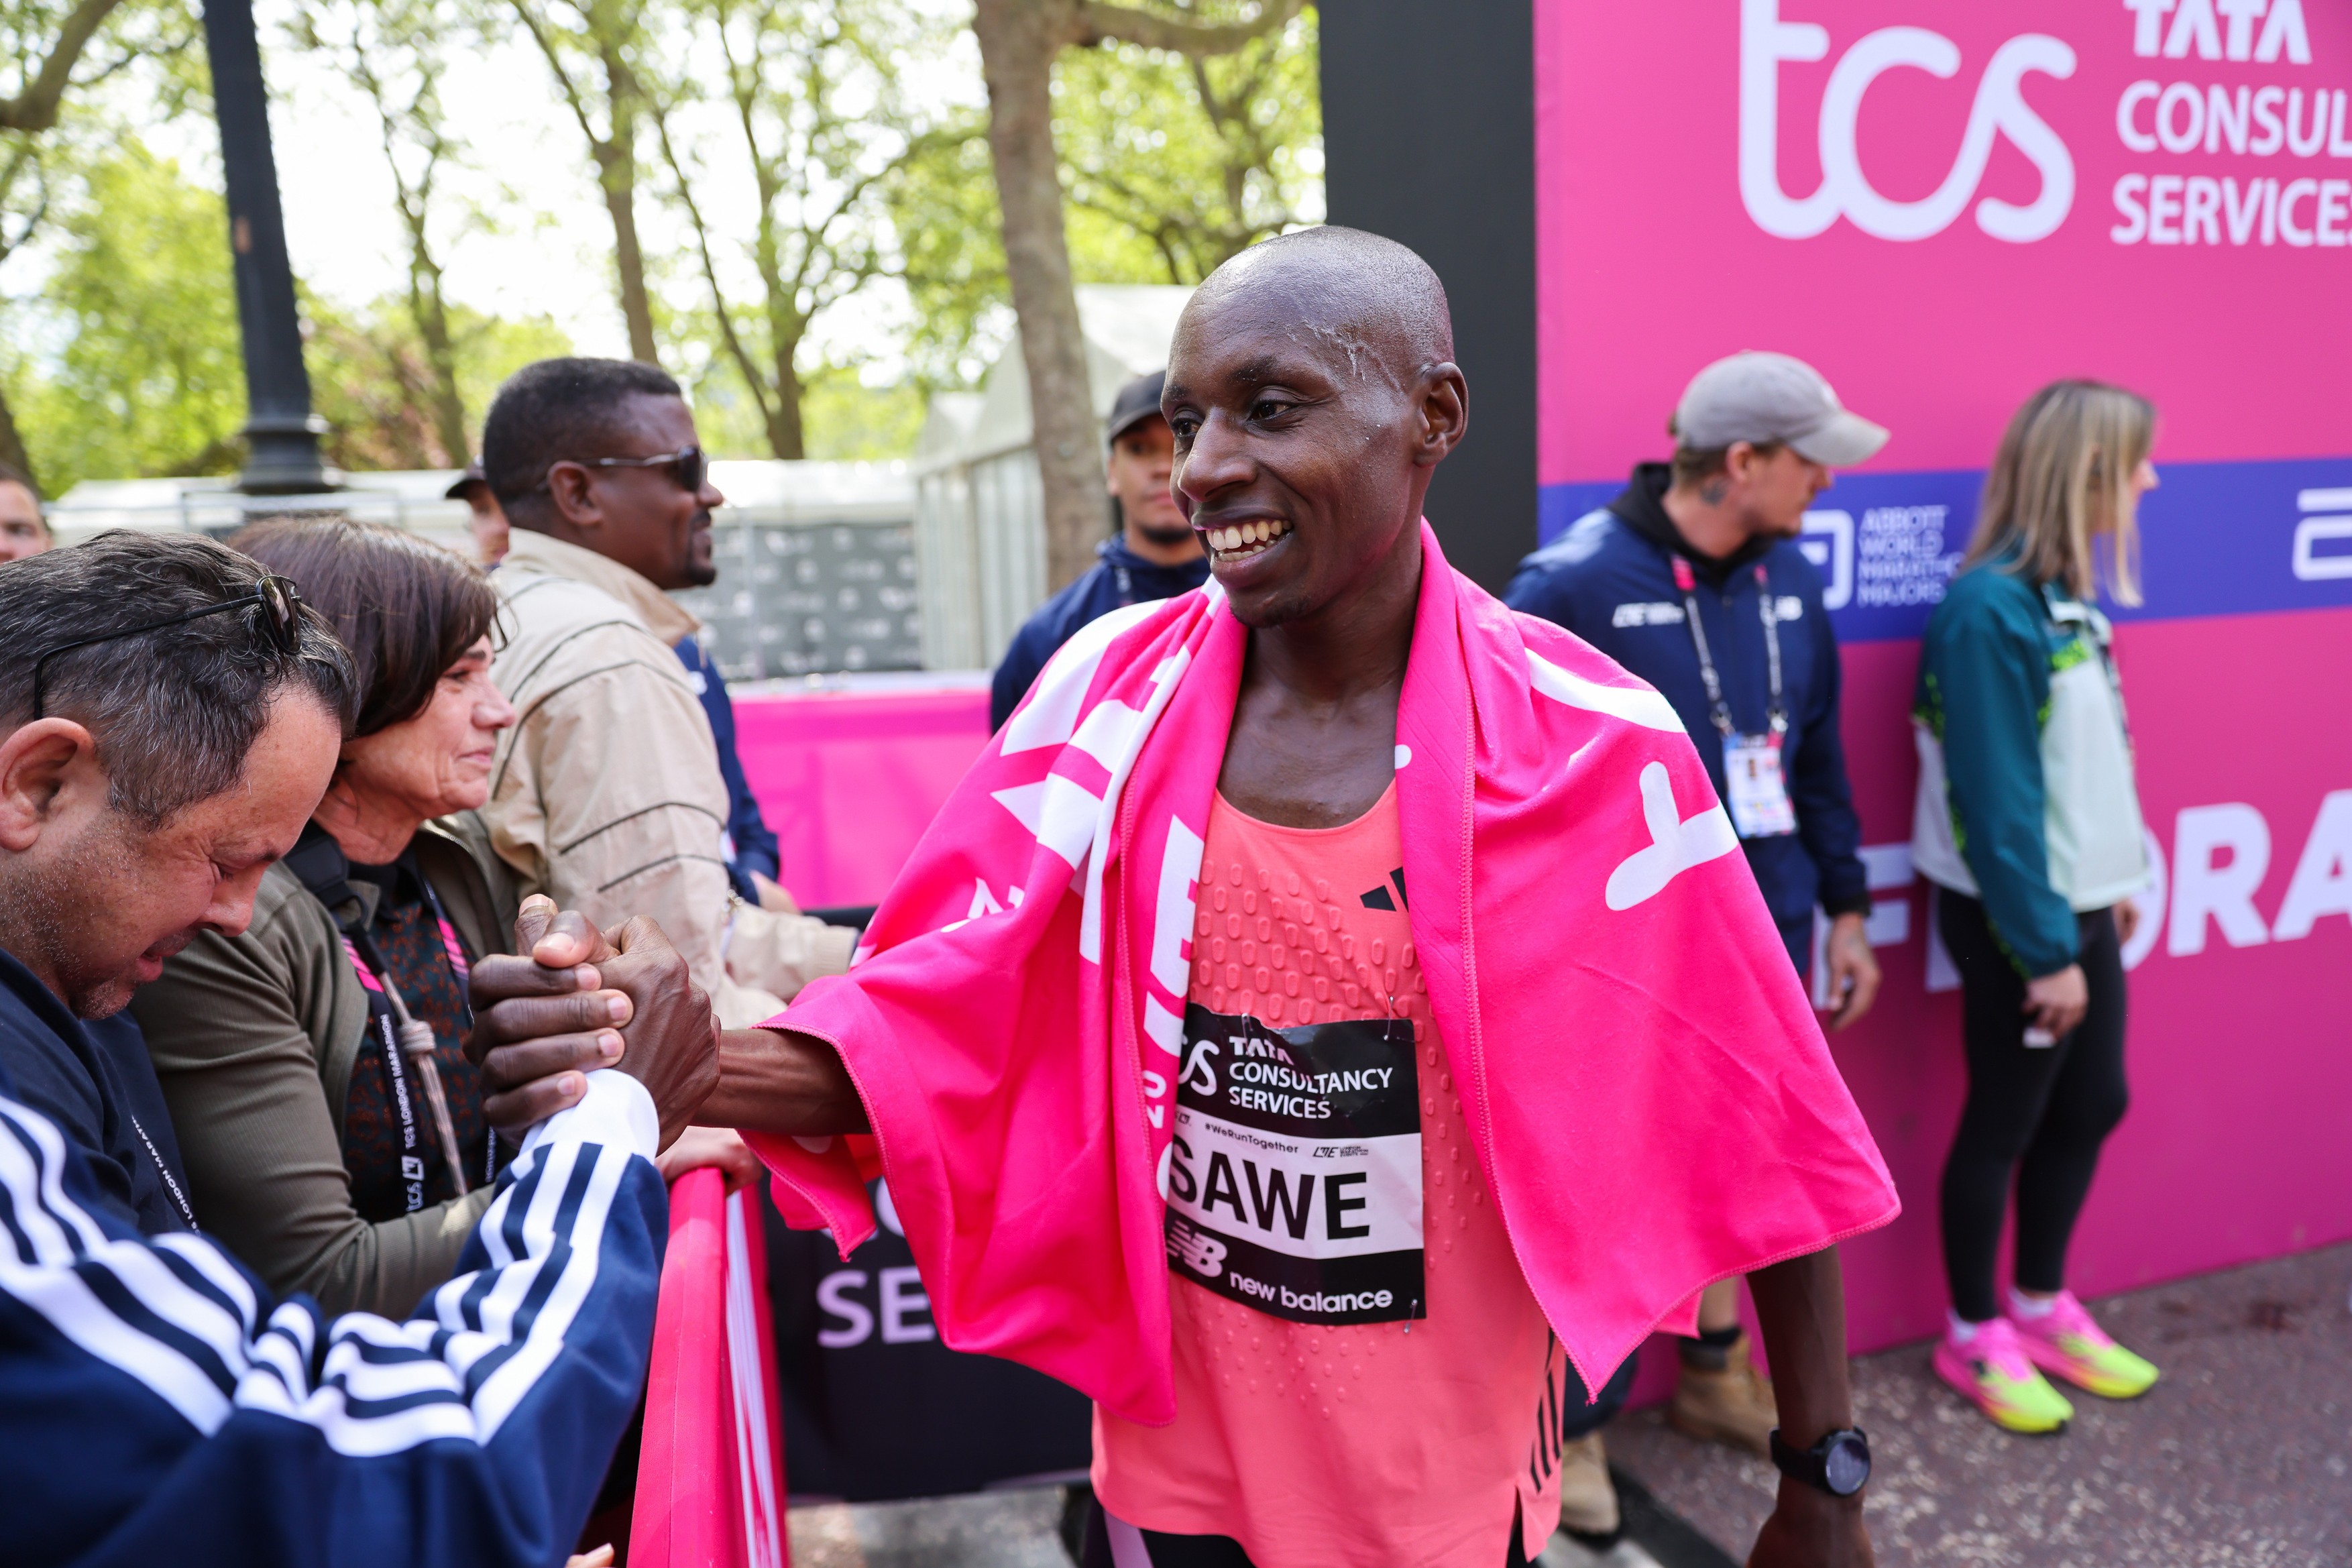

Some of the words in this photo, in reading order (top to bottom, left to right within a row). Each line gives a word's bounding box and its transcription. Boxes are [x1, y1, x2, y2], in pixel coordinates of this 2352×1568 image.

[2123, 0, 2312, 64] TATA
[1738, 0, 2078, 243] tcs
[2116, 80, 2352, 158] CONSUL
[2110, 173, 2352, 247] SERVICE
[380, 1014, 402, 1078] MARATHON
[1229, 1035, 1294, 1066] TATA
[394, 1077, 414, 1125] LONDON
[1228, 1086, 1331, 1119] SERVICES
[1229, 1061, 1393, 1095] CONSULTANCY
[404, 1125, 416, 1150] TCS
[1205, 1122, 1298, 1154] #WeRunTogether
[162, 1169, 194, 1221] LONDON
[1168, 1133, 1370, 1241] SAWE
[1229, 1271, 1276, 1302] new
[1280, 1285, 1393, 1313] balance
